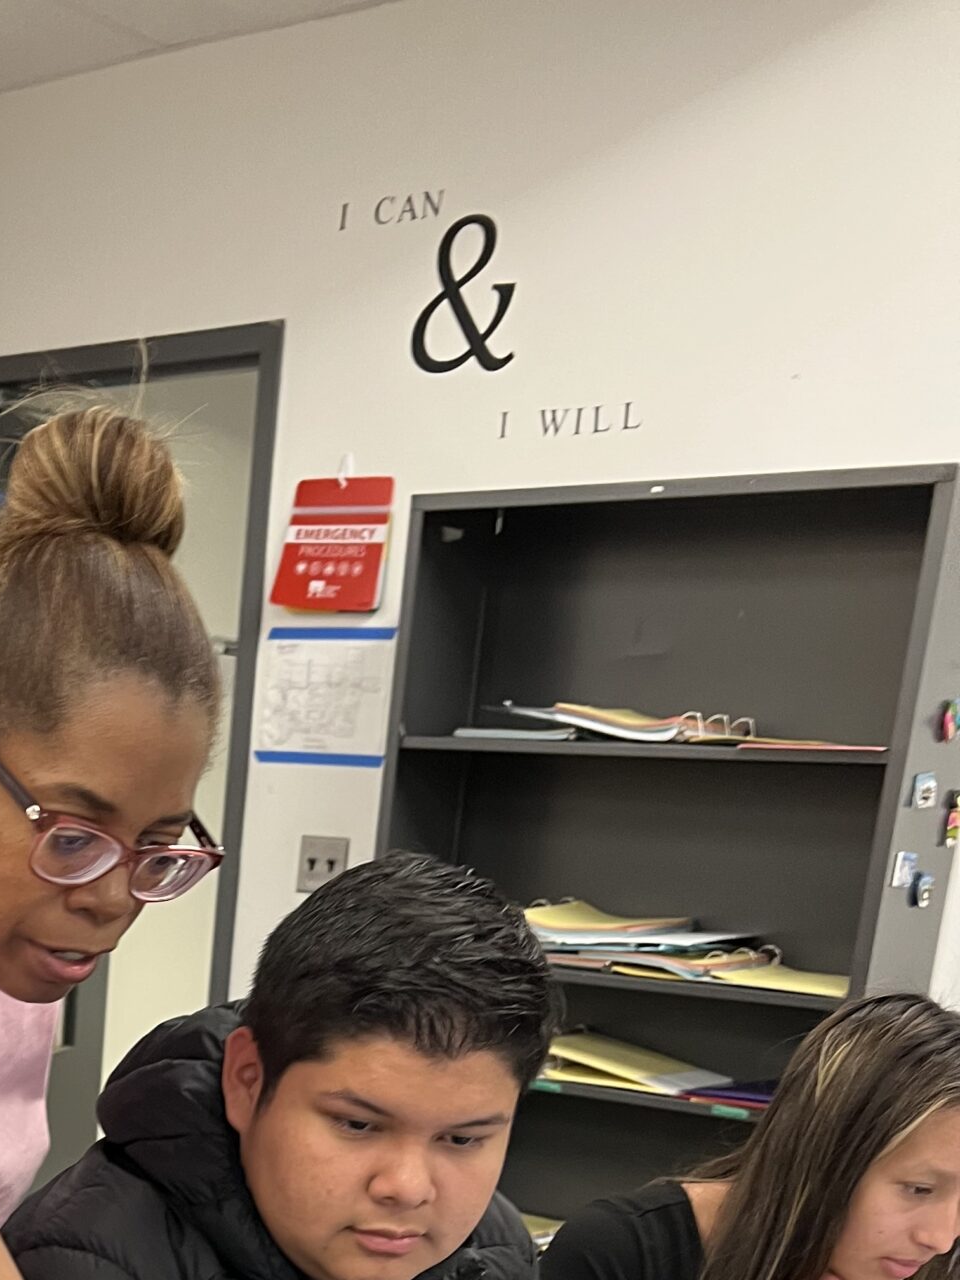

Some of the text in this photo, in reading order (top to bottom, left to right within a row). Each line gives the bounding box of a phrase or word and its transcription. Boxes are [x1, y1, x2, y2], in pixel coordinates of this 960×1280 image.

[338, 188, 445, 231] I CAN
[410, 213, 517, 373] &
[498, 401, 644, 439] I WILL
[295, 527, 377, 541] EMERGENCY
